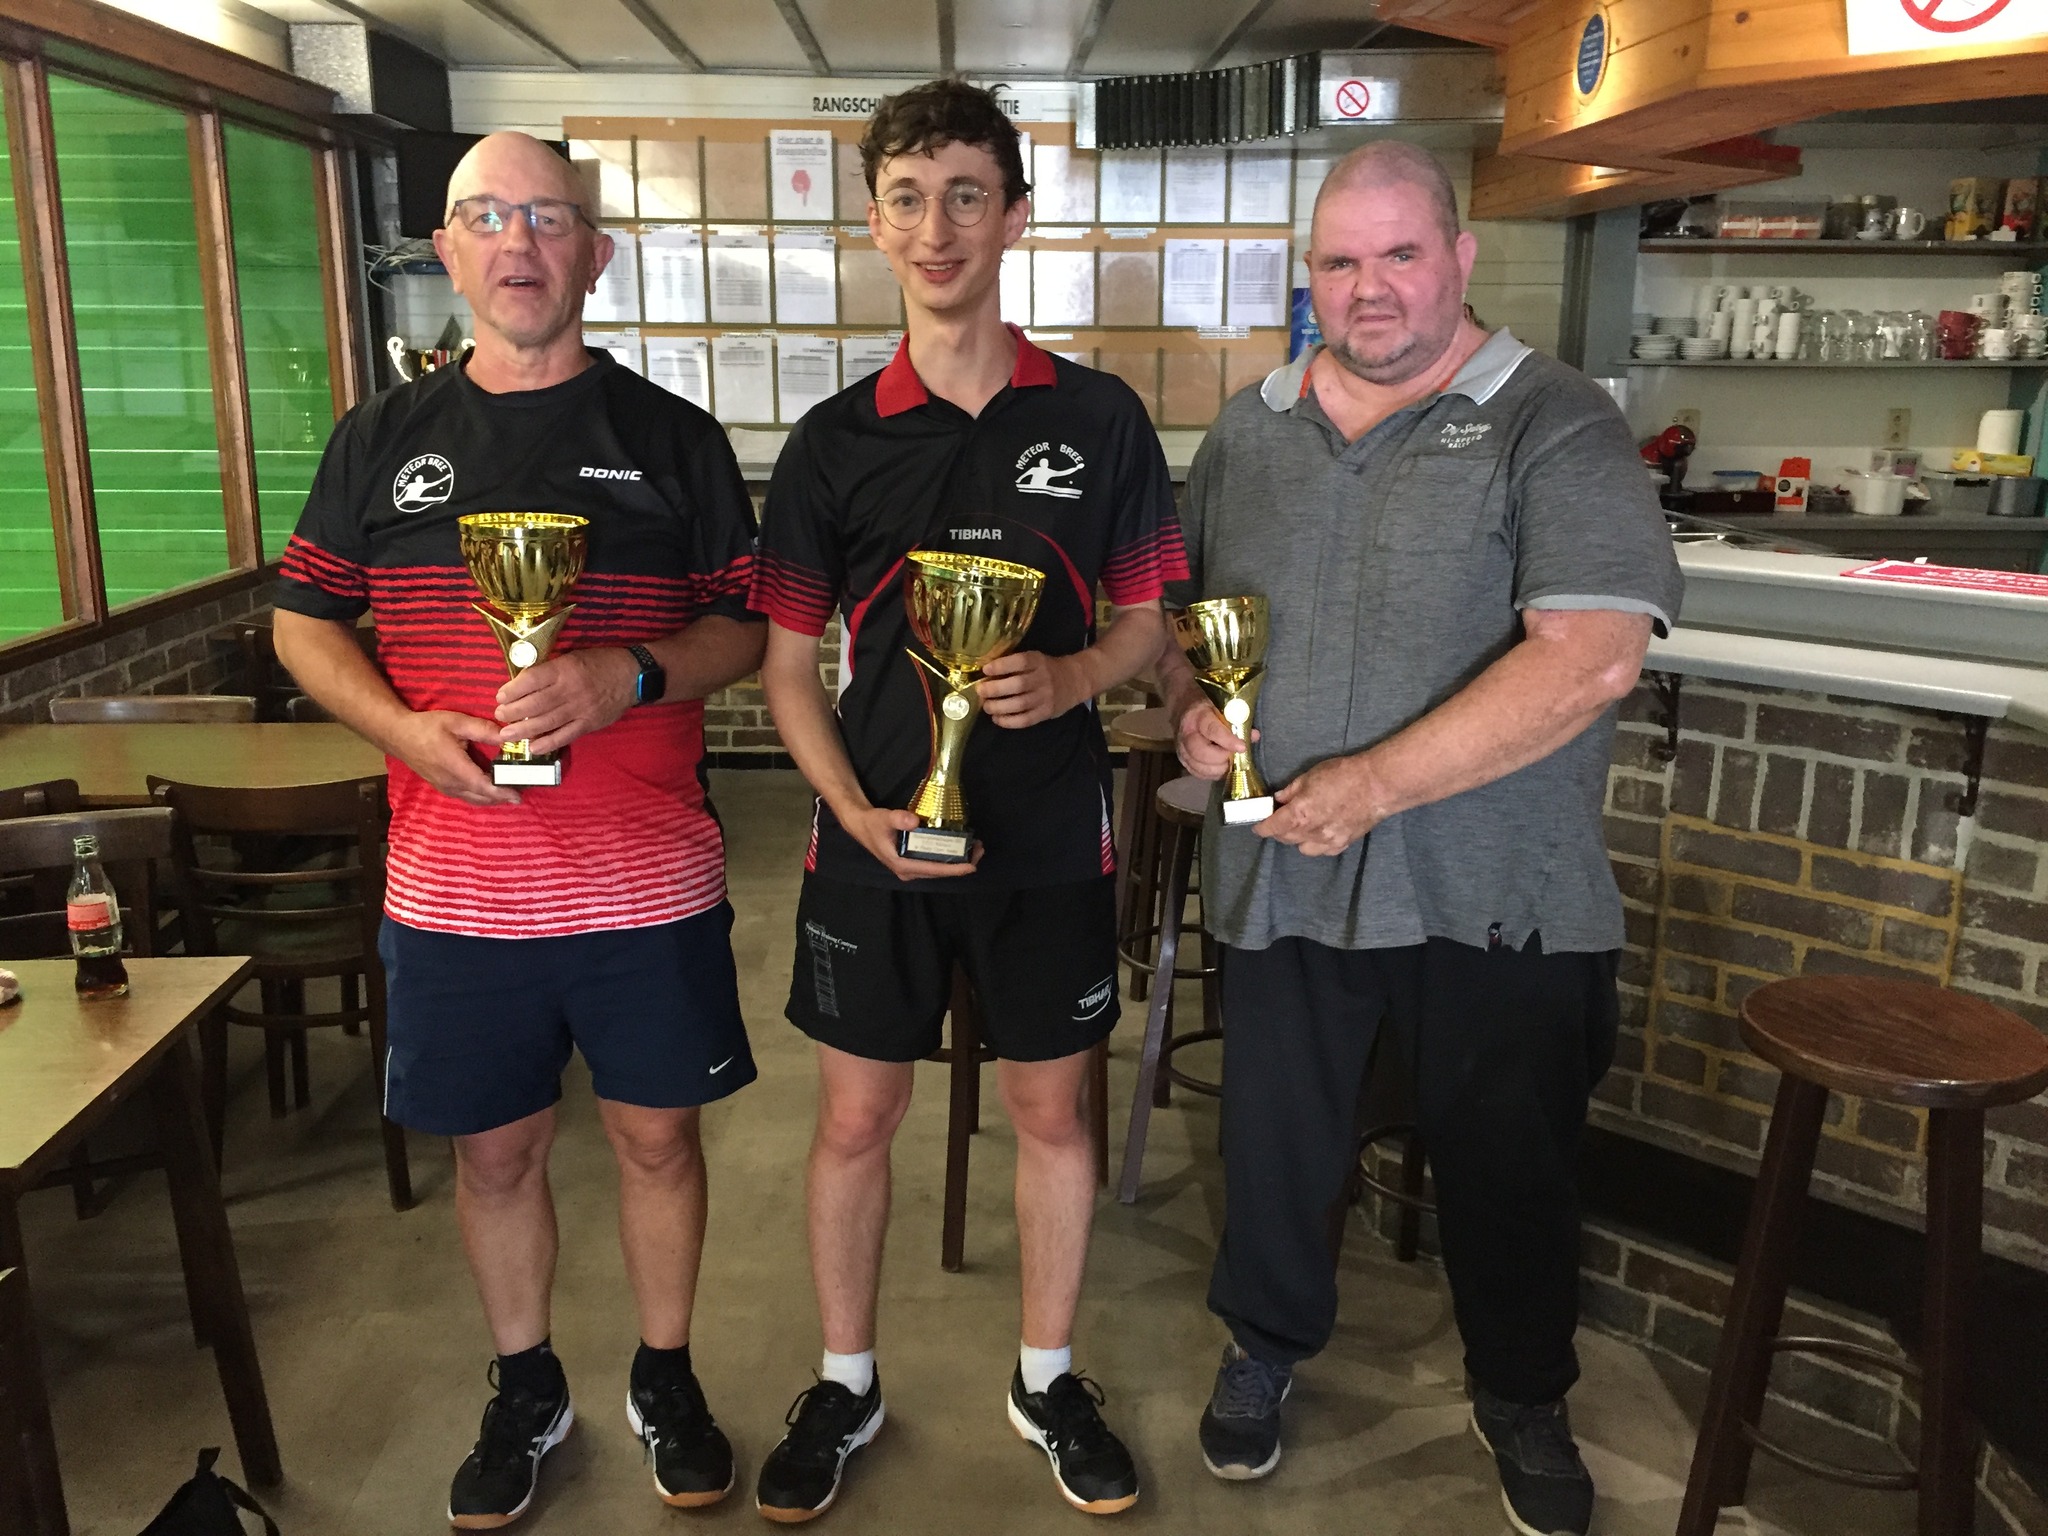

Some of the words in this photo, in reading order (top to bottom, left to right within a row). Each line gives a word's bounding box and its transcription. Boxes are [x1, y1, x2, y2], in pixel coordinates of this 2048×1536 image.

[813, 97, 881, 113] RANGSCHI
[1015, 441, 1051, 471] METEOR
[1059, 443, 1084, 465] BREE
[397, 457, 427, 487] METEOR
[427, 457, 448, 473] BREE
[579, 466, 643, 481] DONIC
[949, 528, 1002, 541] TIBHAR
[1077, 983, 1111, 1010] TIBHAR
